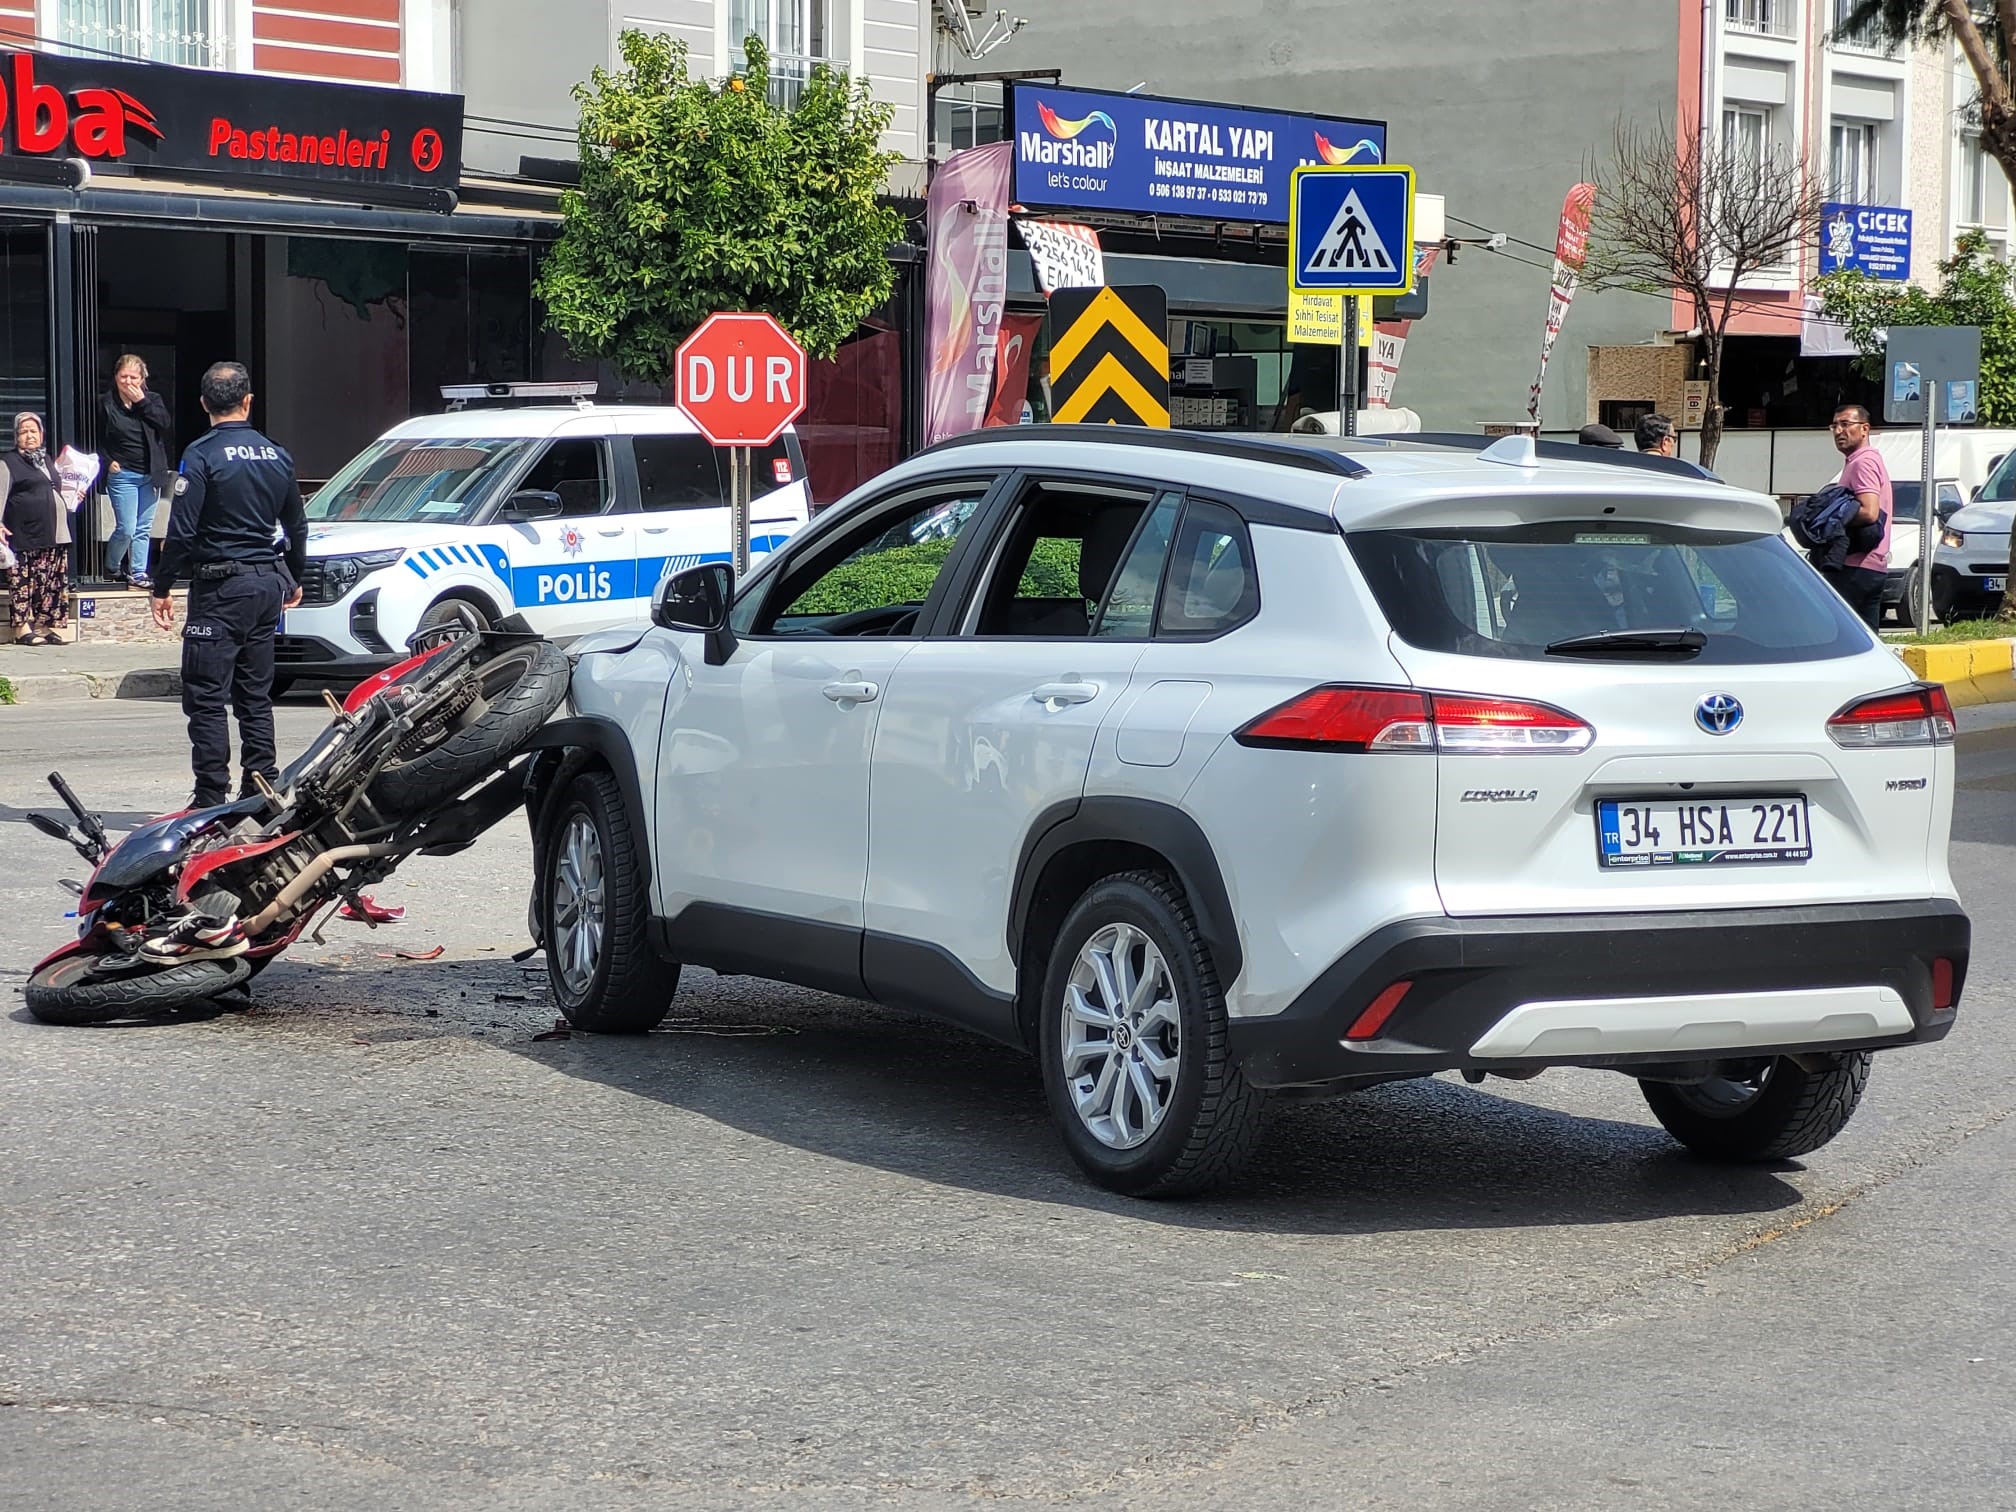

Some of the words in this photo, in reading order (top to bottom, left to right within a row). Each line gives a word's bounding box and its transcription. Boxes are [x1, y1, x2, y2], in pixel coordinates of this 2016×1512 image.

[0, 53, 126, 157] ba
[208, 117, 390, 169] Pastaneleri
[417, 133, 437, 166] 3
[1020, 131, 1108, 169] Marshall
[1144, 118, 1224, 156] KARTAL
[1228, 126, 1273, 161] YAPI
[1047, 170, 1070, 188] let's
[1071, 174, 1108, 191] colour
[1154, 156, 1193, 178] İNŞAAT
[1194, 163, 1264, 184] MALZEMELERİ
[1149, 182, 1155, 197] 0
[1156, 184, 1170, 198] 506
[1171, 185, 1185, 199] 138
[1186, 186, 1196, 200] 97
[1197, 187, 1207, 200] 37
[1211, 188, 1217, 201] 0
[1218, 189, 1232, 203] 533
[1233, 190, 1246, 204] 021
[1043, 244, 1068, 267] 256
[1062, 235, 1080, 256] 92
[1081, 244, 1096, 266] 92
[966, 222, 1006, 414] Marshall
[1294, 325, 1339, 338] Malzemeleri
[1315, 311, 1339, 323] Tesisat
[689, 355, 793, 403] DUR
[775, 461, 789, 473] 112
[537, 563, 611, 602] POLİS
[1989, 578, 2000, 590] 34
[1460, 789, 1538, 802] COROLLA
[1604, 832, 1621, 845] TR
[1622, 807, 1661, 847] 34
[1677, 805, 1734, 846] HSA
[1751, 804, 1800, 843] 221
